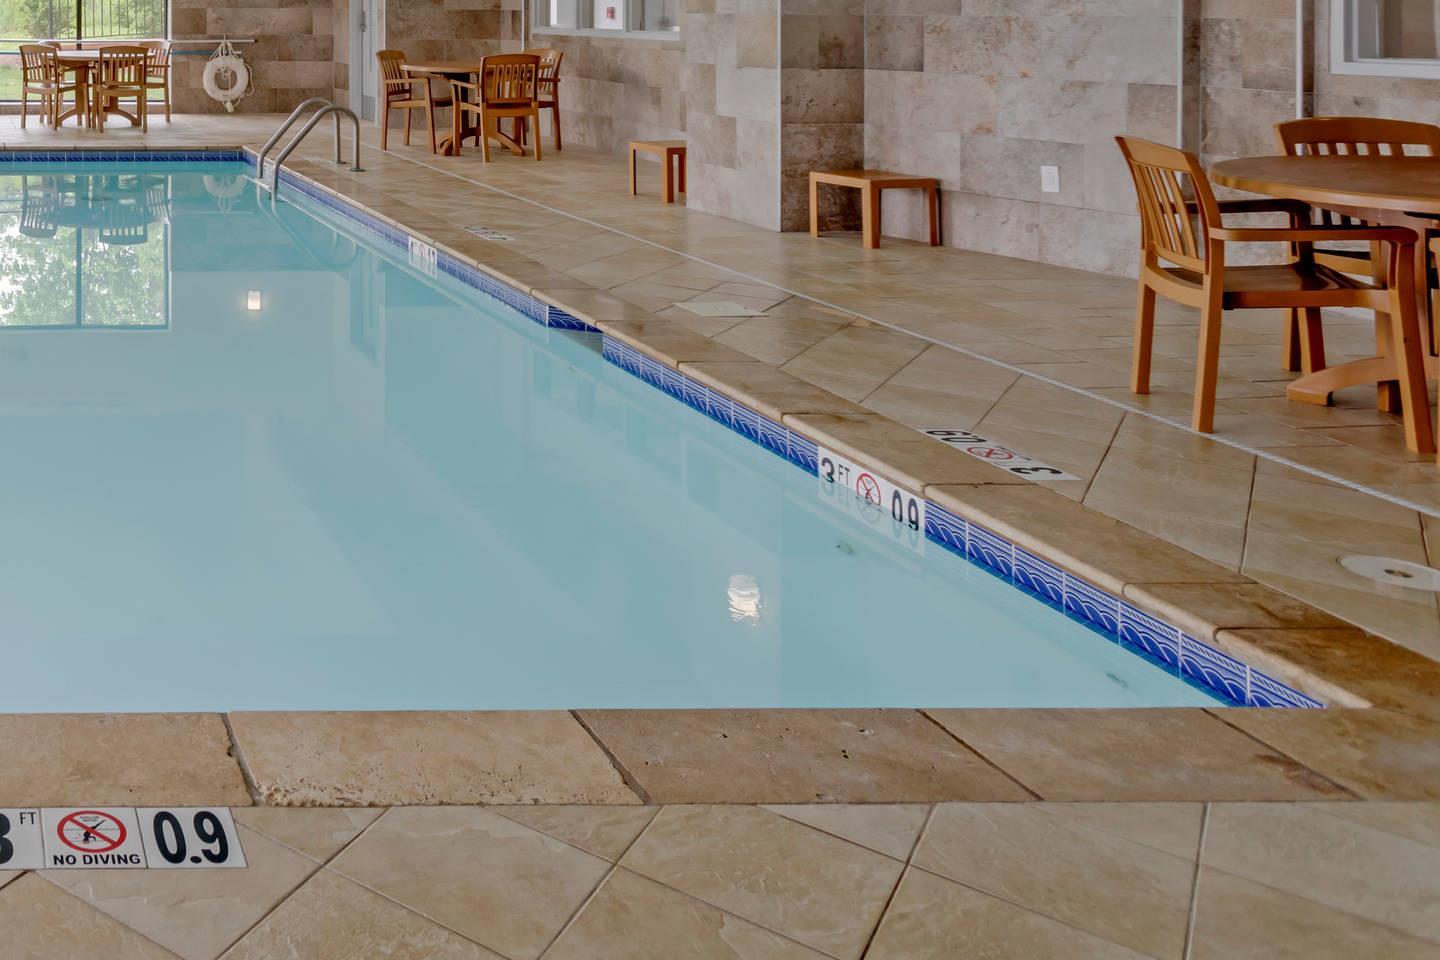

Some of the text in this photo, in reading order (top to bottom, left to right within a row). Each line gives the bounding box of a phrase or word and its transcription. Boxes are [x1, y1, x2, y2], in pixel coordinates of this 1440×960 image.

[925, 430, 988, 443] 0.9
[838, 463, 850, 486] FT
[1009, 466, 1063, 475] 3
[19, 811, 37, 825] FT
[152, 810, 229, 864] 0.9
[53, 853, 141, 865] NO DIVING
